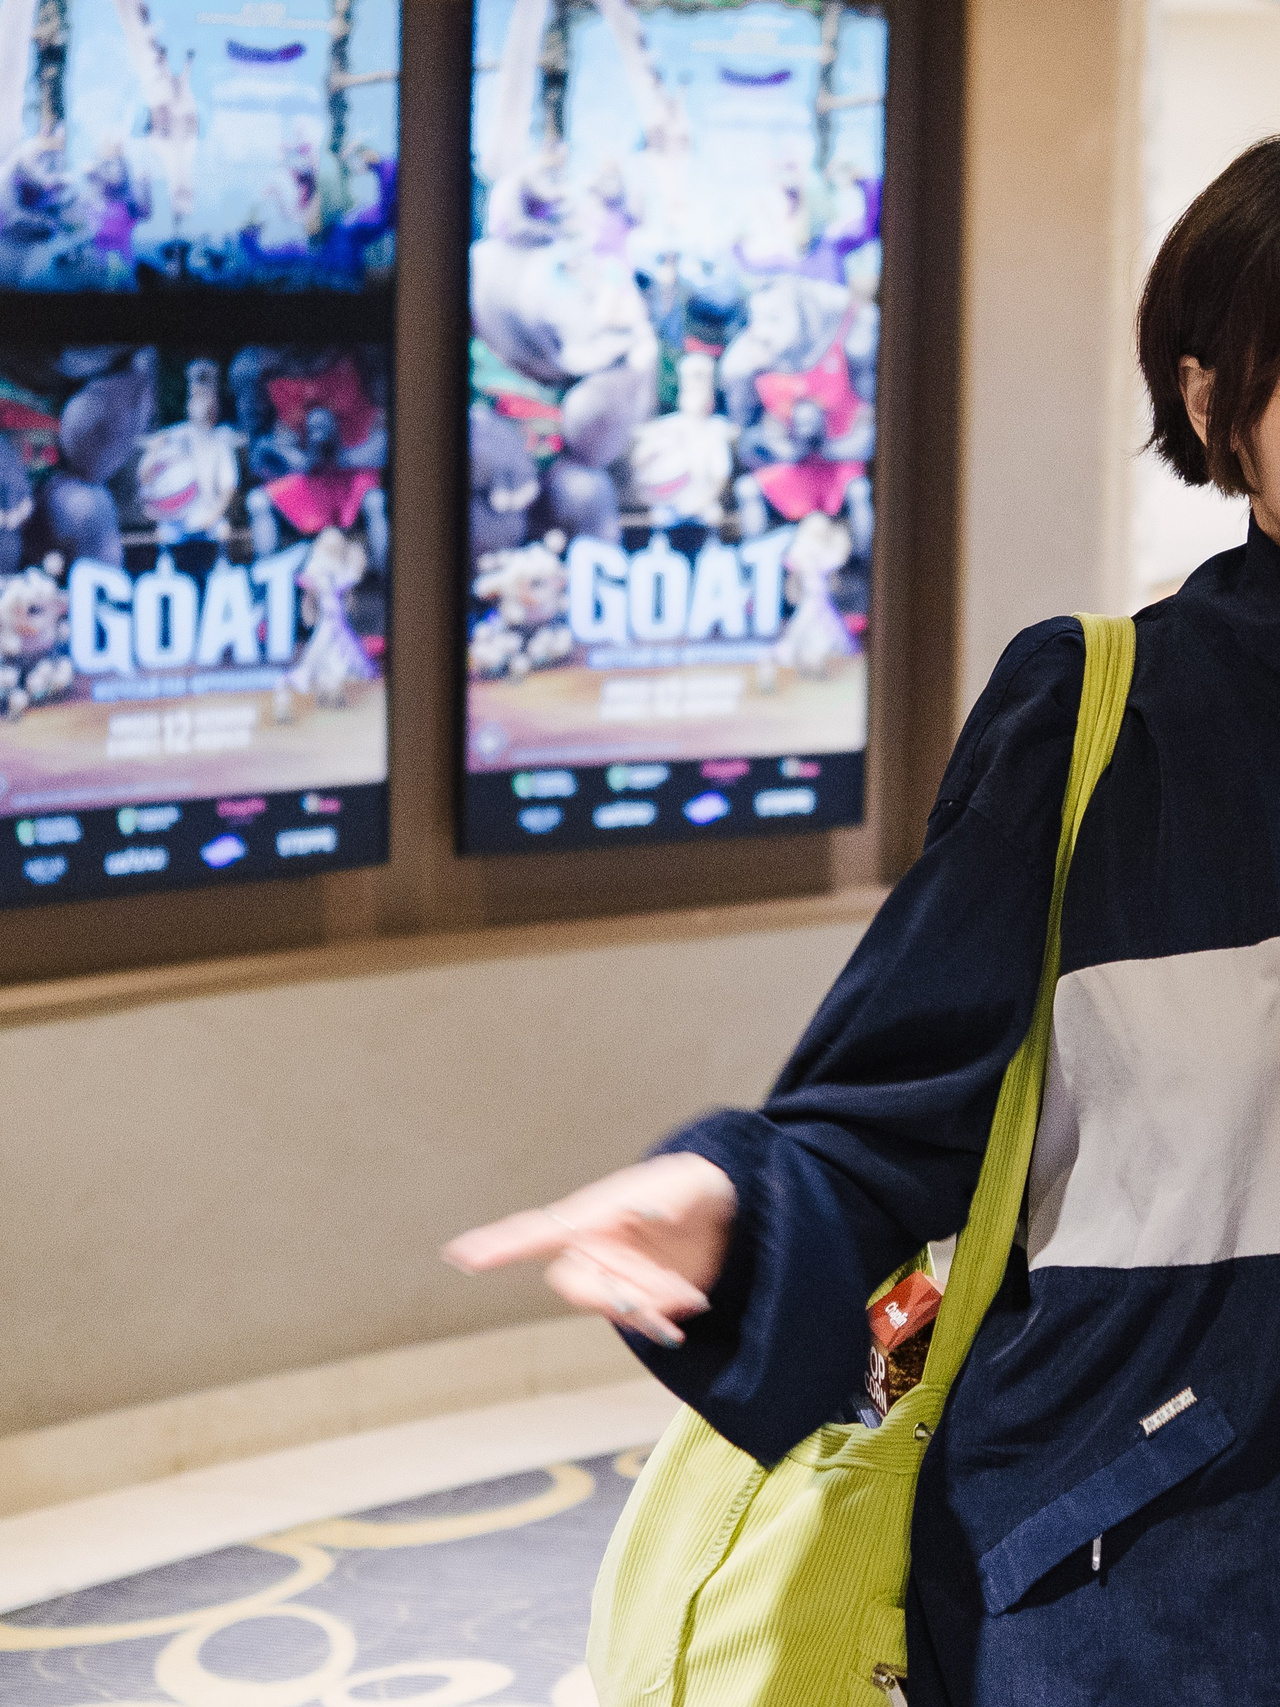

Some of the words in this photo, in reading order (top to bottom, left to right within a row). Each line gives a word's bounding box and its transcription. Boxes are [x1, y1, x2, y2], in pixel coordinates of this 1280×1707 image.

[69, 541, 312, 677] GOAT
[567, 529, 792, 645] GOAT
[869, 1346, 885, 1384] OP
